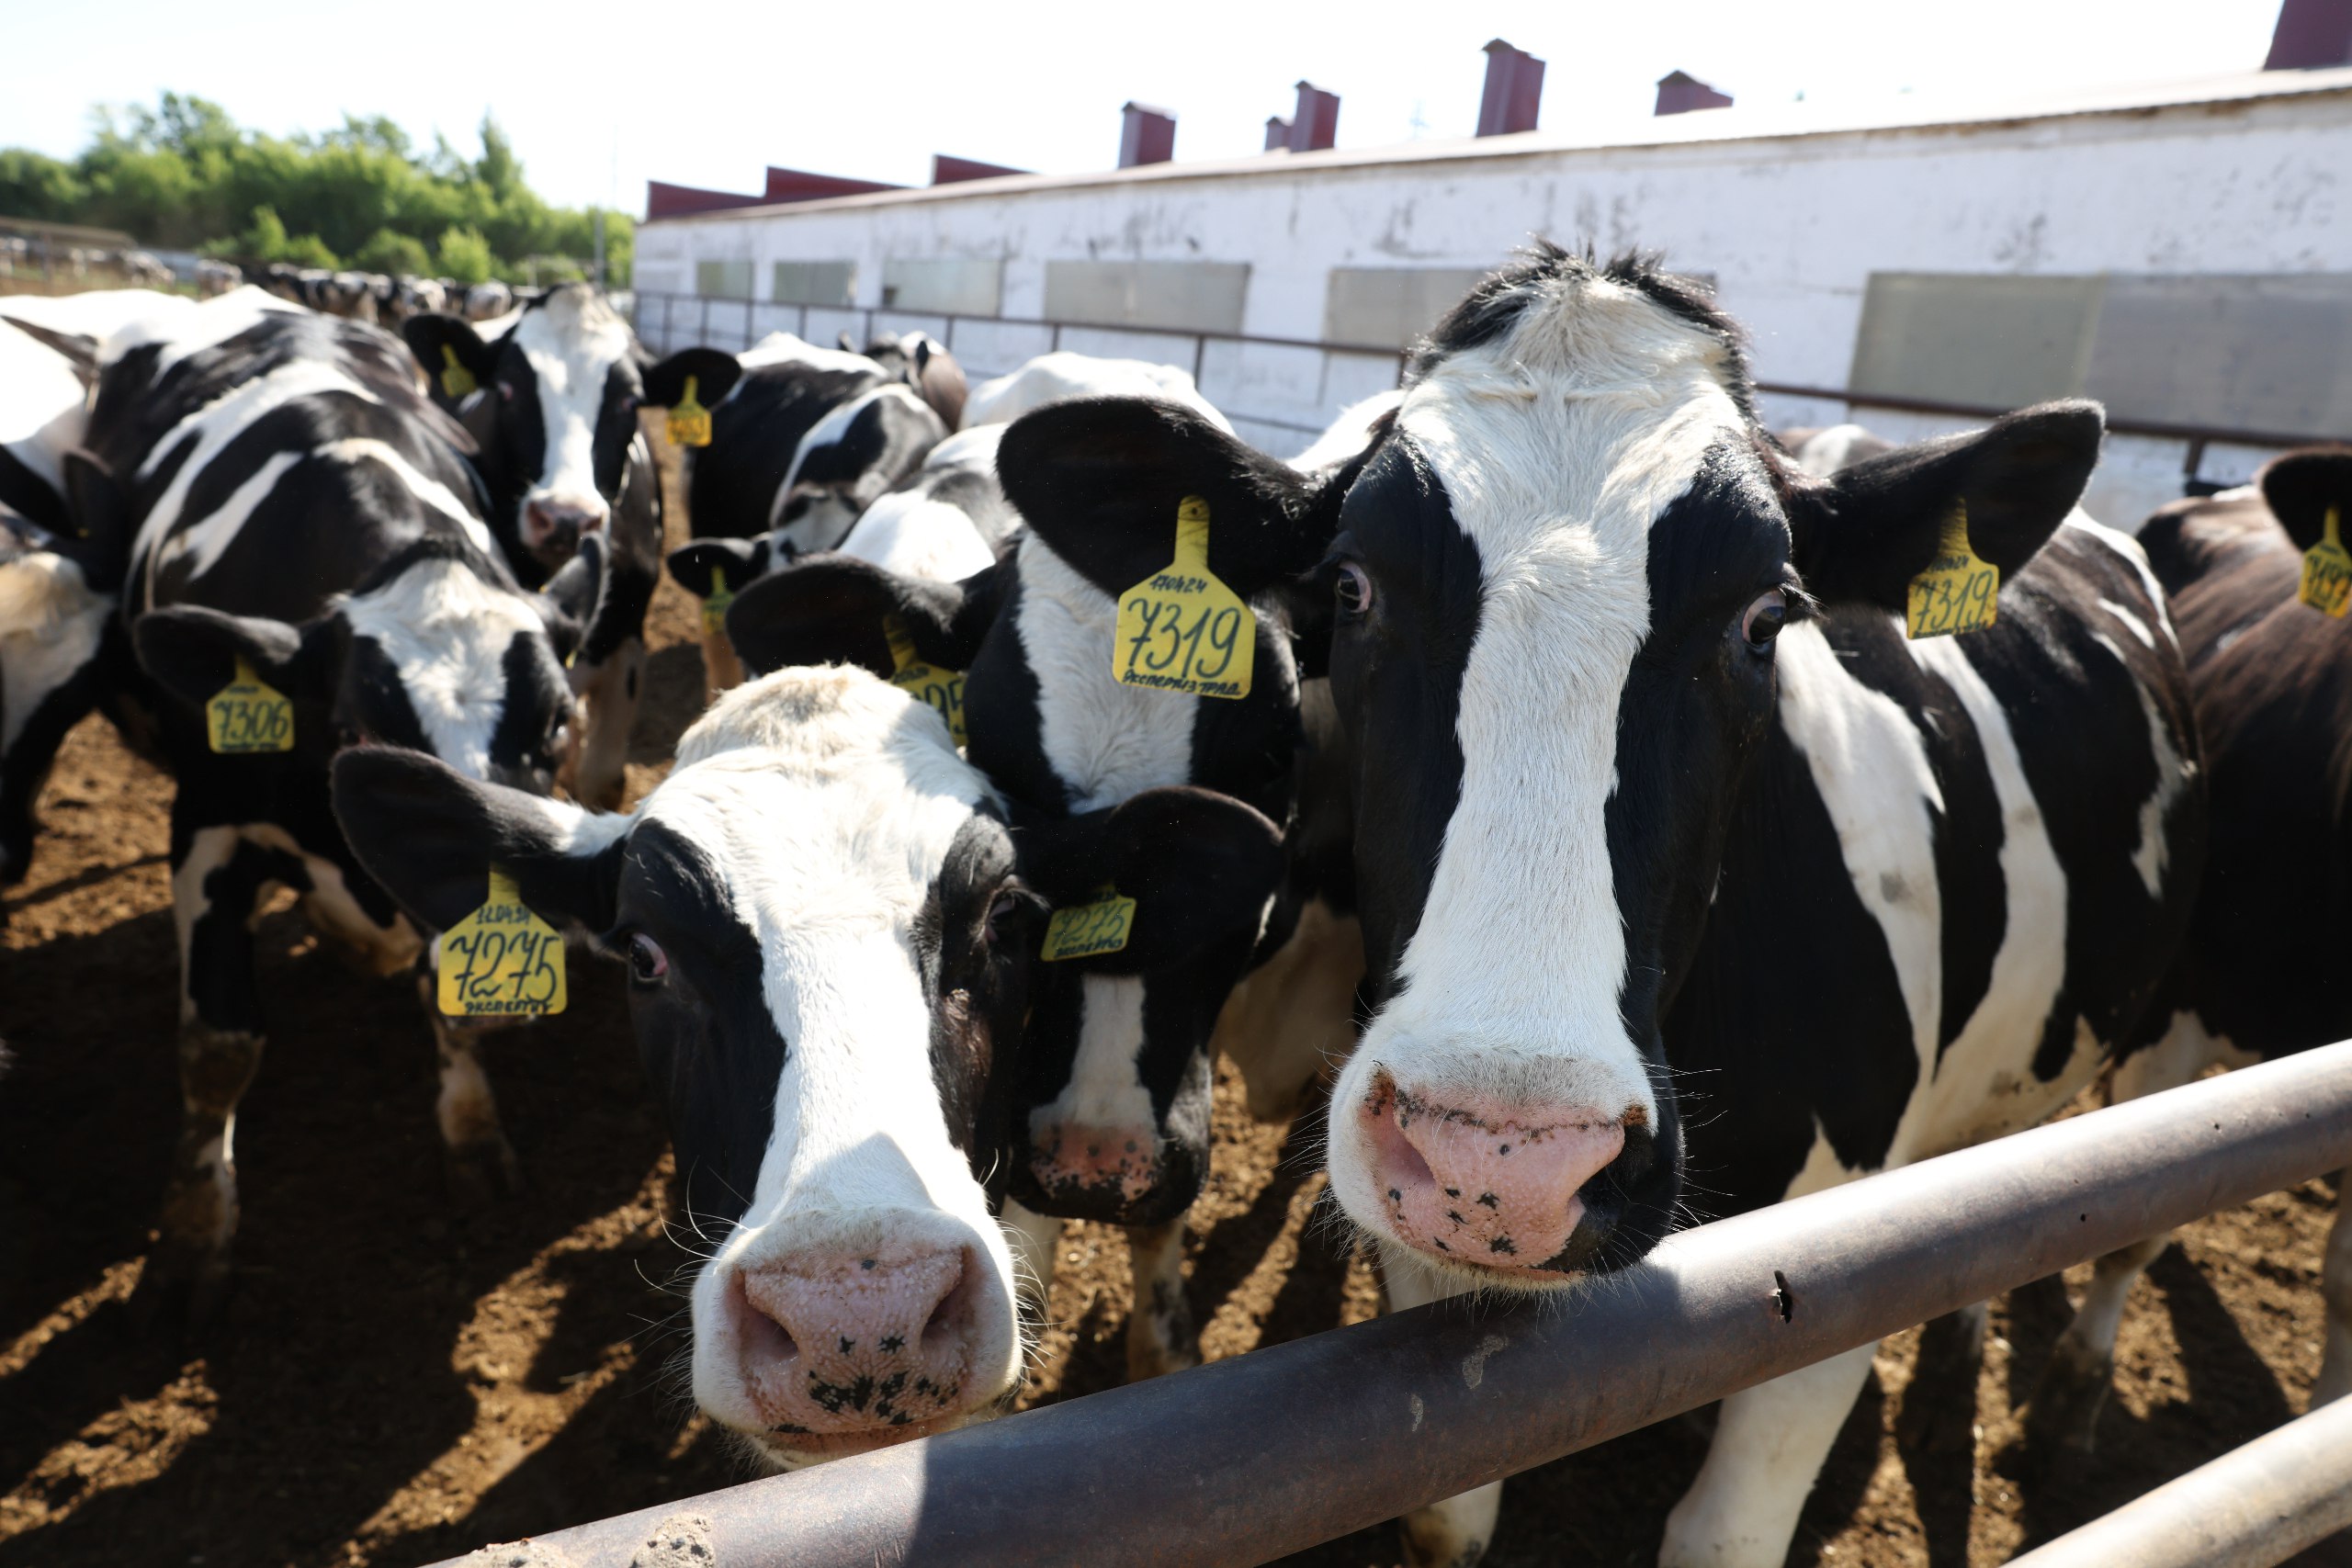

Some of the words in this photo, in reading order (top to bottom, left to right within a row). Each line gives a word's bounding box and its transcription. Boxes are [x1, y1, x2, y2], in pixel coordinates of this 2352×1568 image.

[1915, 570, 1994, 631] 7319
[1127, 597, 1241, 679] 7319
[212, 699, 290, 740] 7306
[447, 930, 560, 1004] 7275
